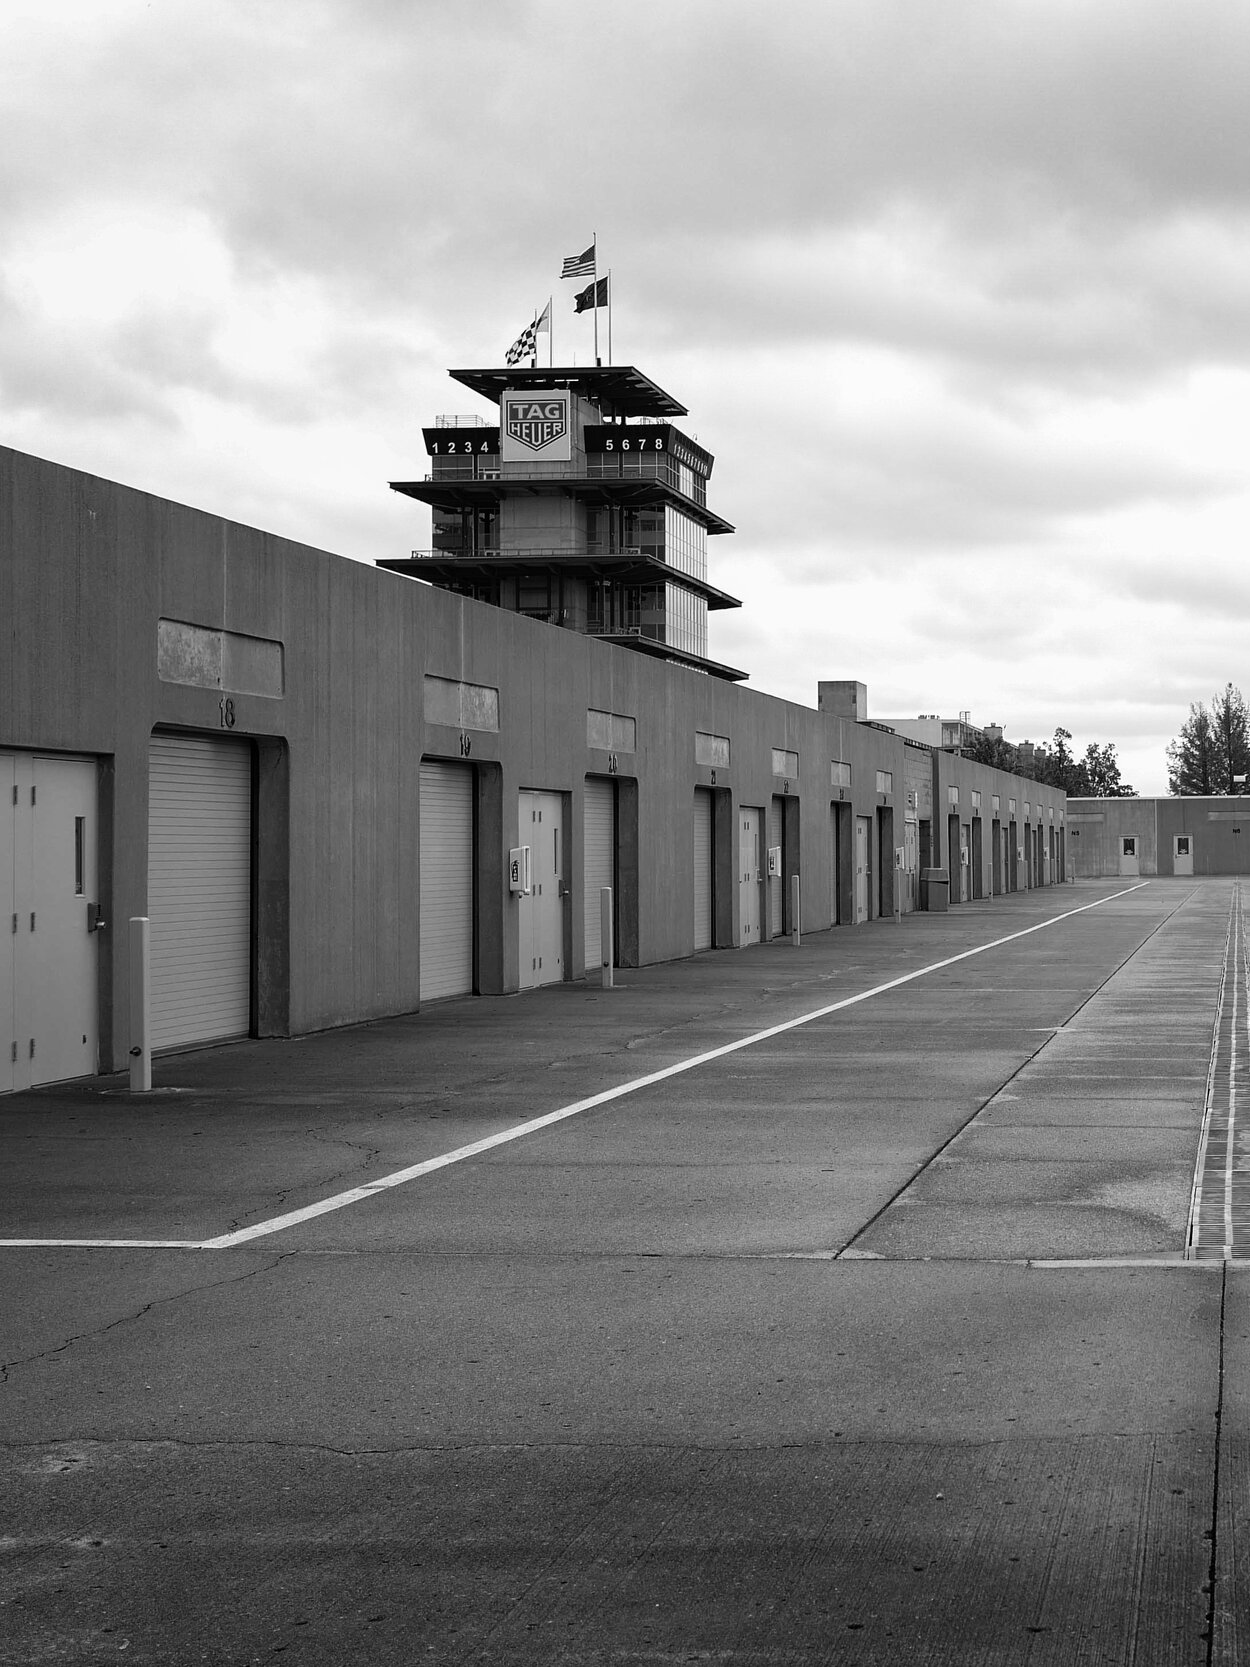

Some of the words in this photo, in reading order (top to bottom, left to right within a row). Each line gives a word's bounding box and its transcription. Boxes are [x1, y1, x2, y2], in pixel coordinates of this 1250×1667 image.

[512, 404, 560, 419] TAG
[511, 423, 562, 446] HEUER
[606, 440, 613, 450] 5
[622, 440, 630, 450] 6
[639, 439, 646, 450] 7
[655, 439, 662, 450] 8
[432, 442, 438, 453] 1
[448, 442, 456, 453] 2
[464, 442, 472, 453] 3
[480, 441, 489, 452] 4
[218, 698, 236, 728] 18
[460, 733, 471, 757] 19
[608, 753, 618, 774] 20
